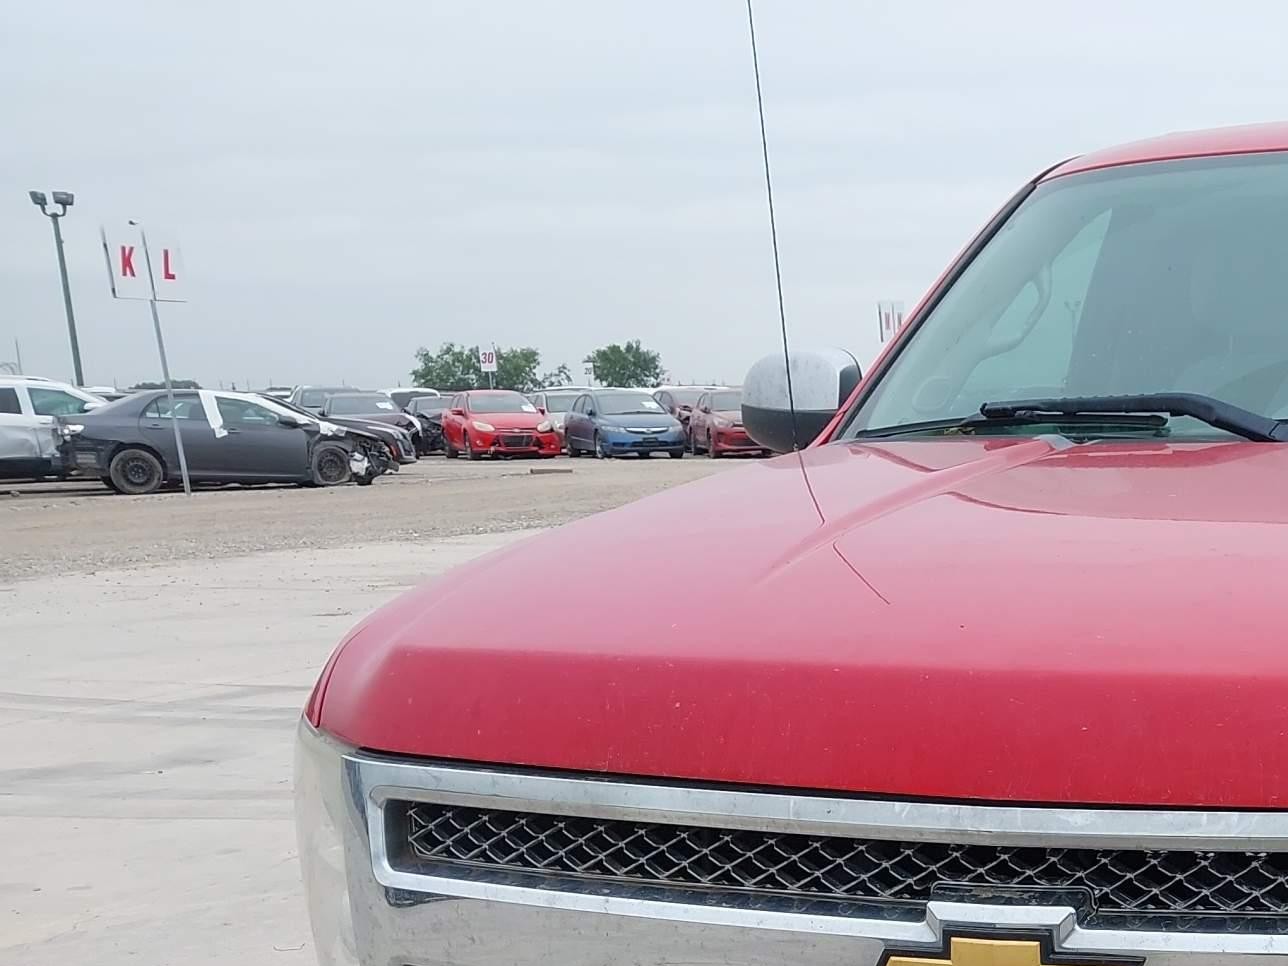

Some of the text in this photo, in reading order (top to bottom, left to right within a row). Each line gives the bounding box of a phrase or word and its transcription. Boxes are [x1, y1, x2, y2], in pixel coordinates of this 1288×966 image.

[120, 245, 136, 278] K
[163, 249, 176, 280] L
[481, 352, 494, 365] 30
